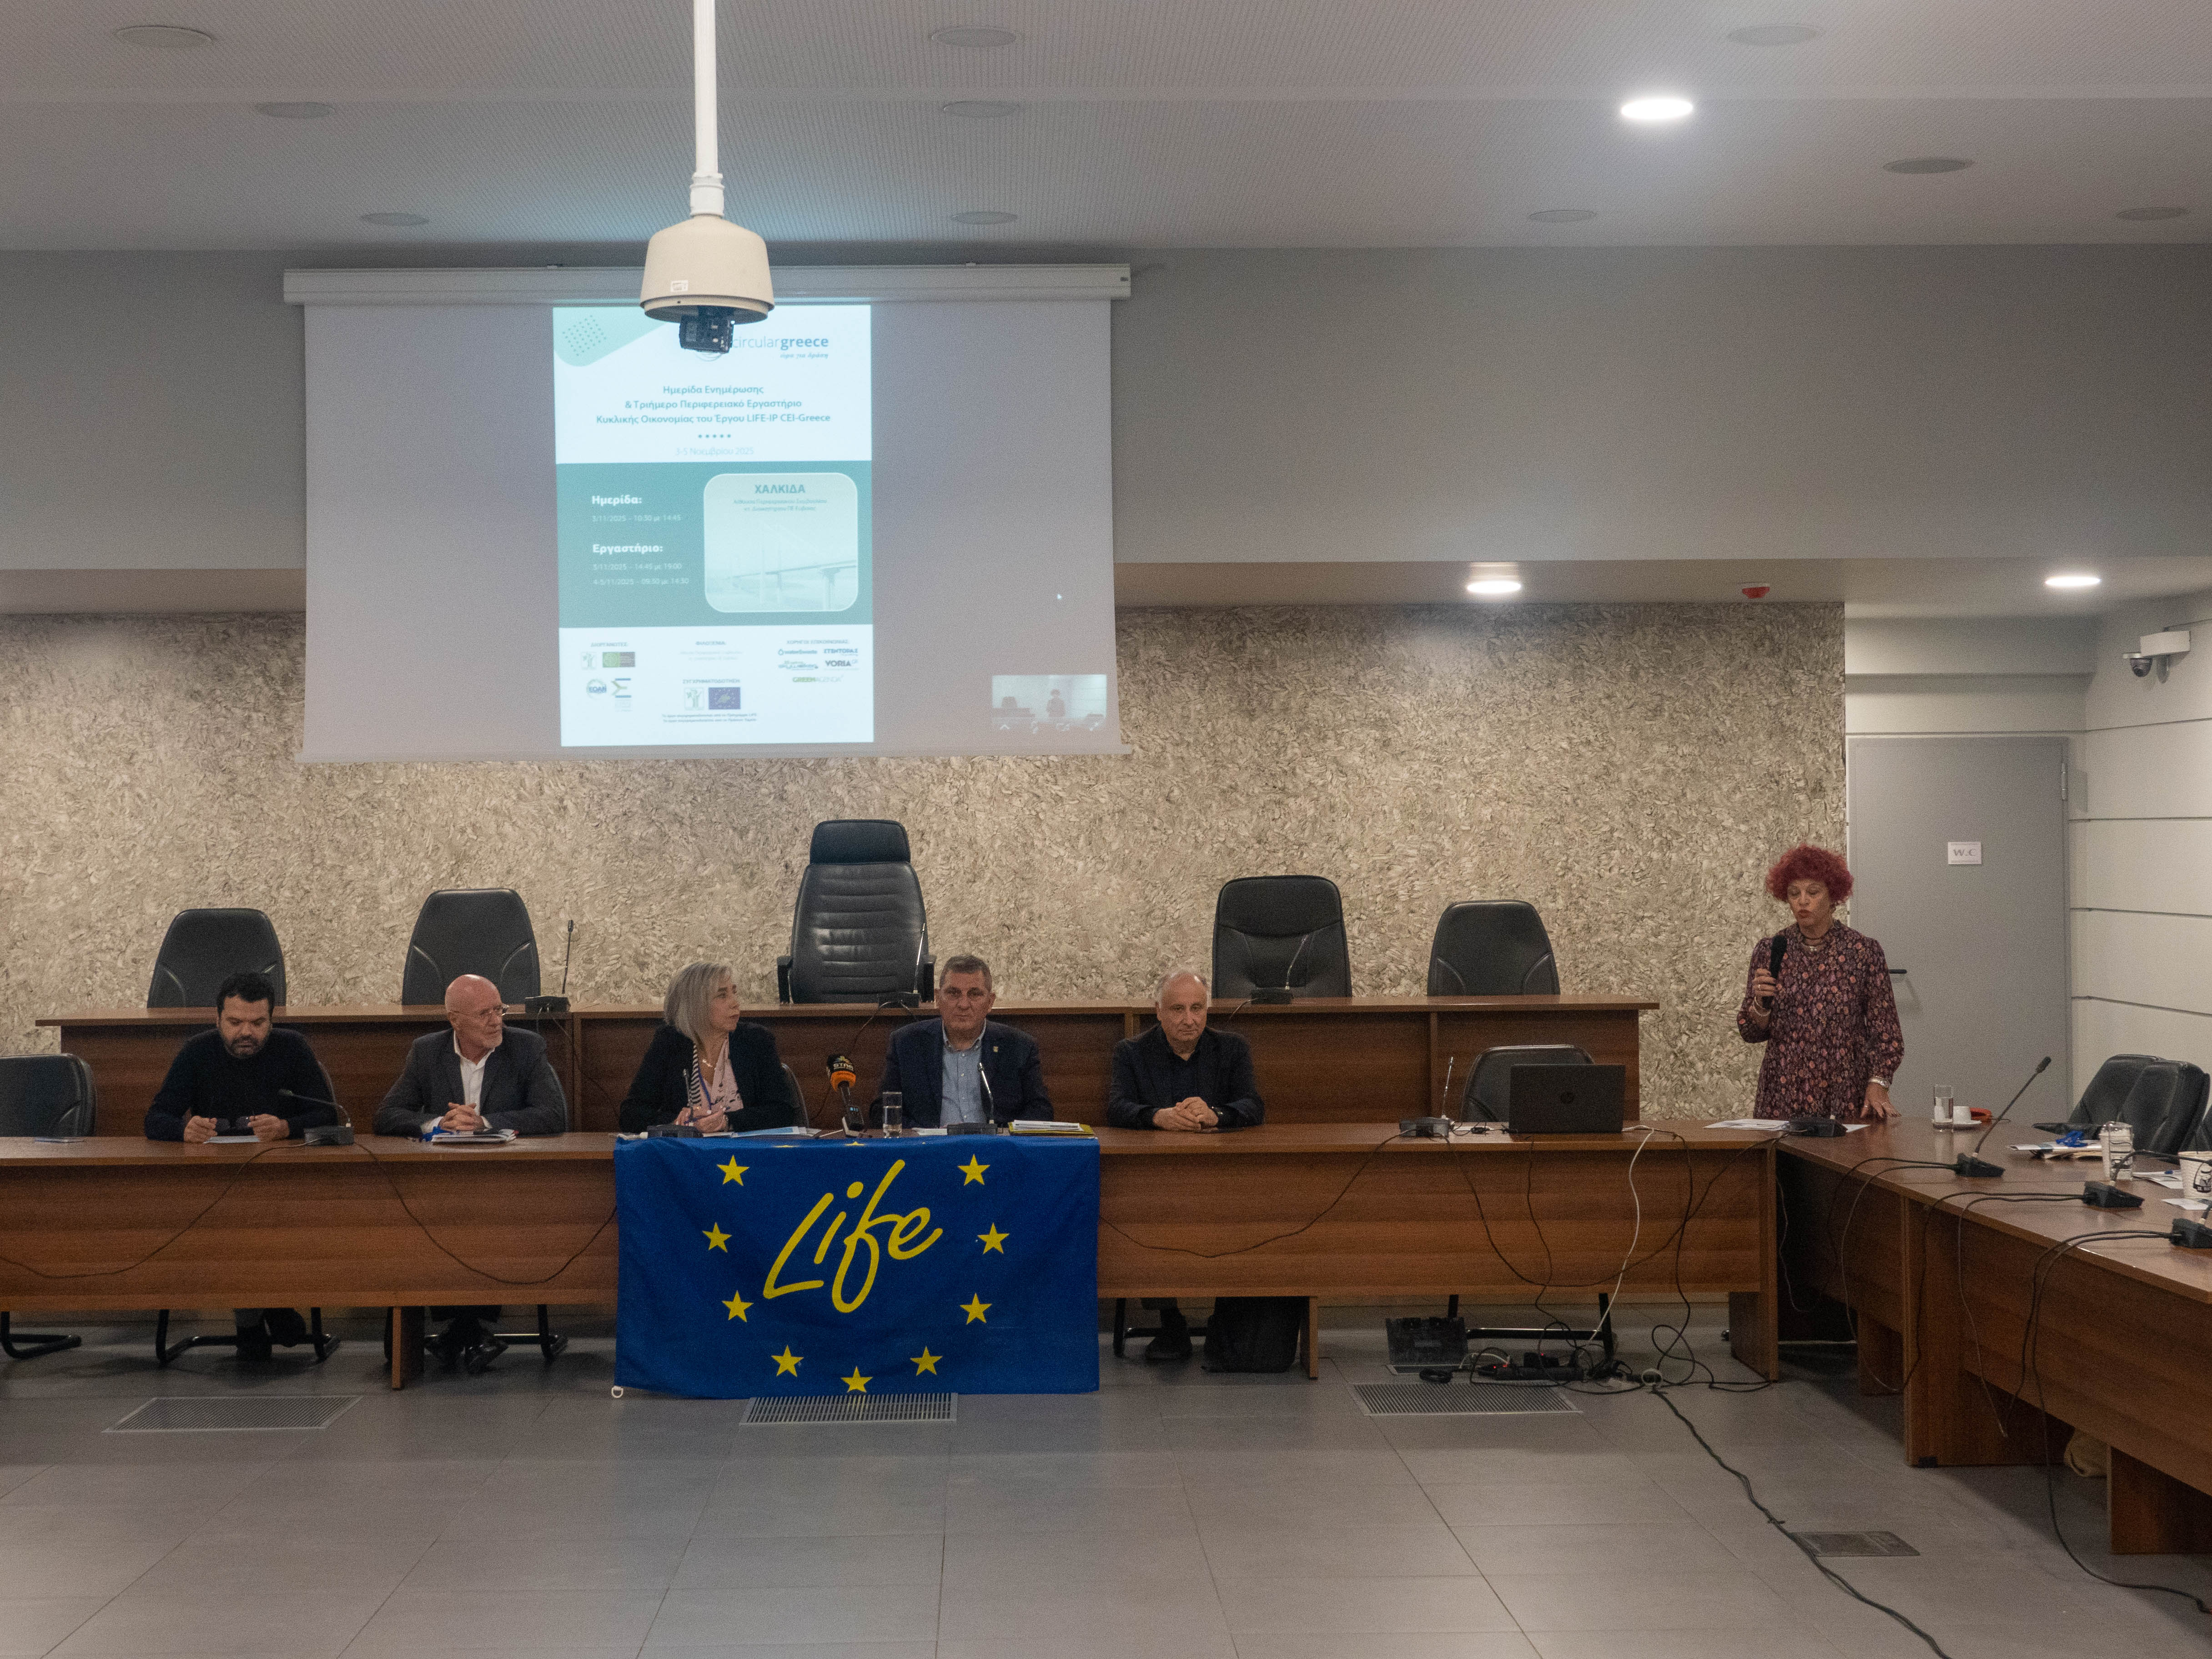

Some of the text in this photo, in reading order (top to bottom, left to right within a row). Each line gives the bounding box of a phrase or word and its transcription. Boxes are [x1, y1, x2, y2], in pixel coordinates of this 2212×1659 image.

[733, 336, 829, 351] circulargreece
[663, 385, 764, 395] Ημερίδα Ενημέρωσης
[625, 399, 802, 410] & Τριήμερο Περιφερειακό Εργαστήριο
[596, 415, 639, 425] Κυκλικής
[641, 414, 694, 424] Οικονομίας
[714, 414, 744, 424] Έργου
[780, 413, 831, 422] CEI-Greece
[735, 447, 754, 455] 2025
[754, 484, 806, 494] ΧΑΛΚΙΔΑ
[592, 494, 643, 507] Ημερίδα:
[592, 543, 664, 556] Εργαστήριο:
[762, 1159, 943, 1313] Life
